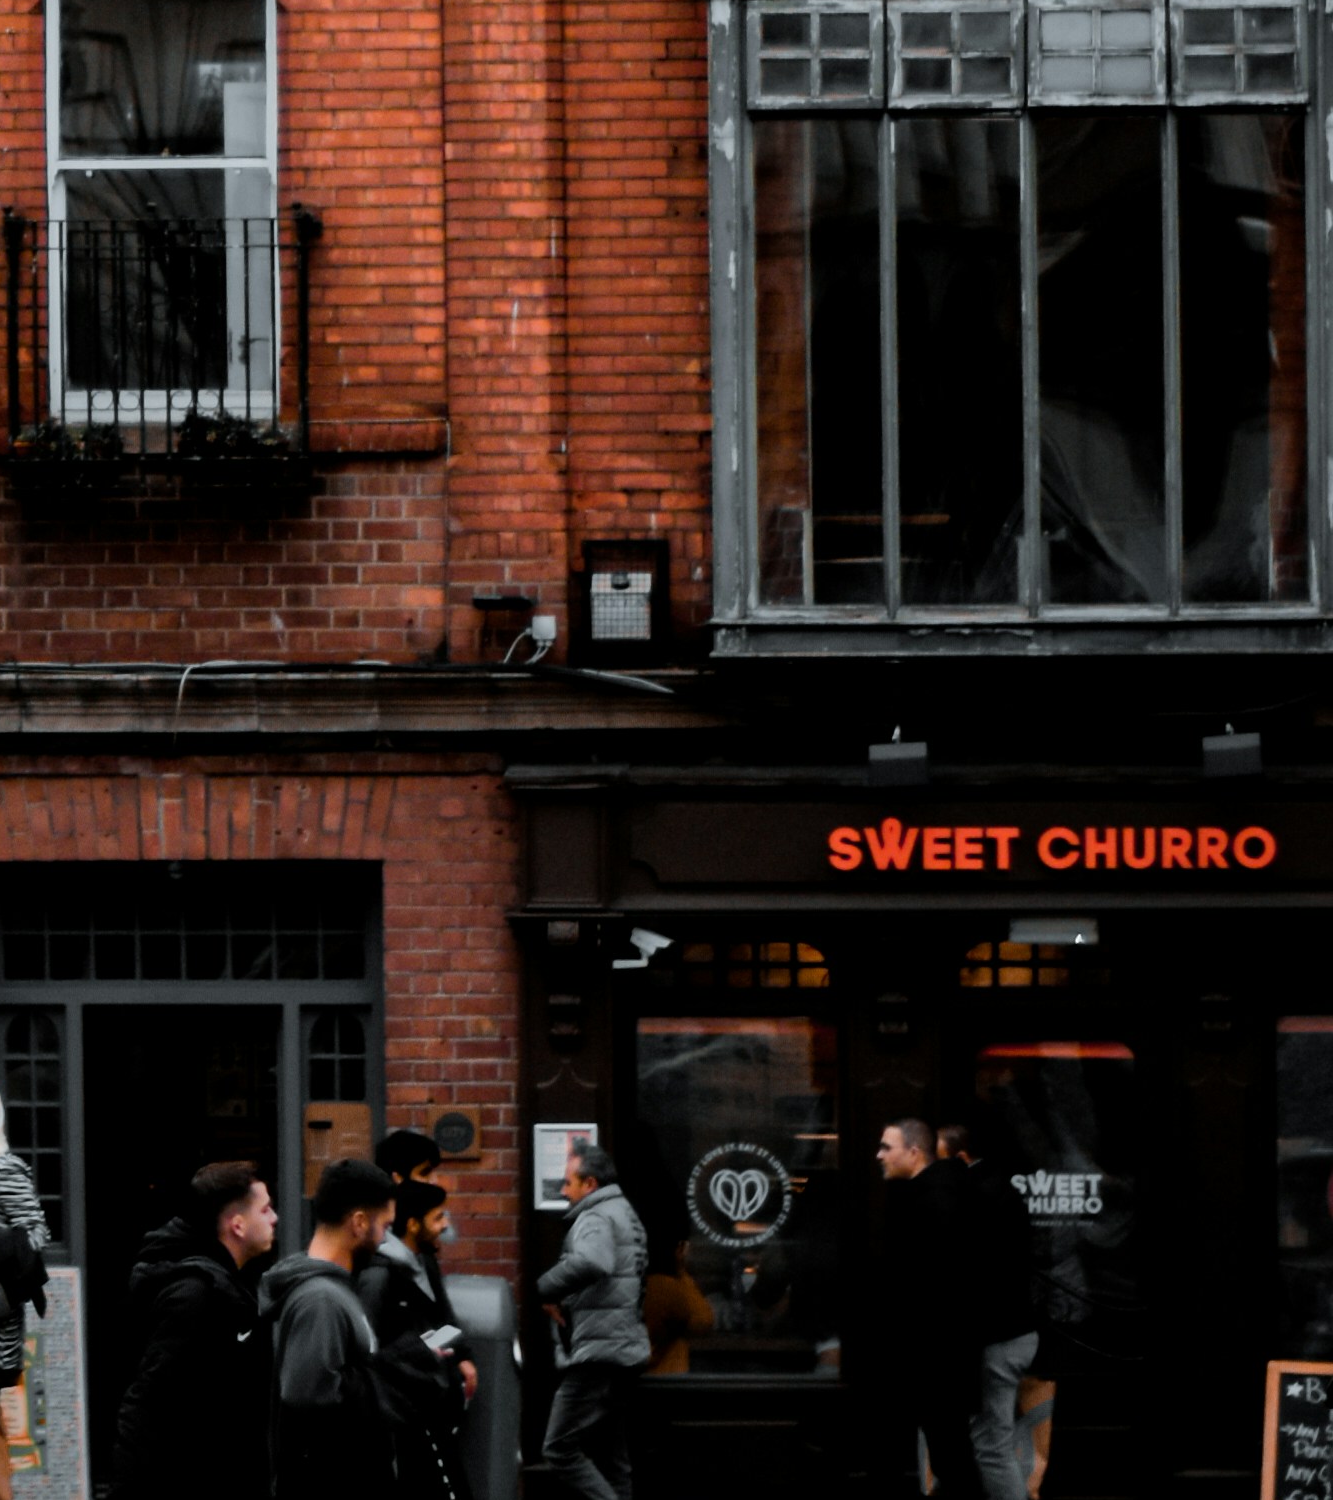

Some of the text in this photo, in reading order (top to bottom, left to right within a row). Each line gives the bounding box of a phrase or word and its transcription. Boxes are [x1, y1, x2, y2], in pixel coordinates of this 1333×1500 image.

[828, 817, 1277, 871] SWEET CHURRO
[1010, 1169, 1103, 1195] SWEET
[1024, 1197, 1103, 1214] HURRO
